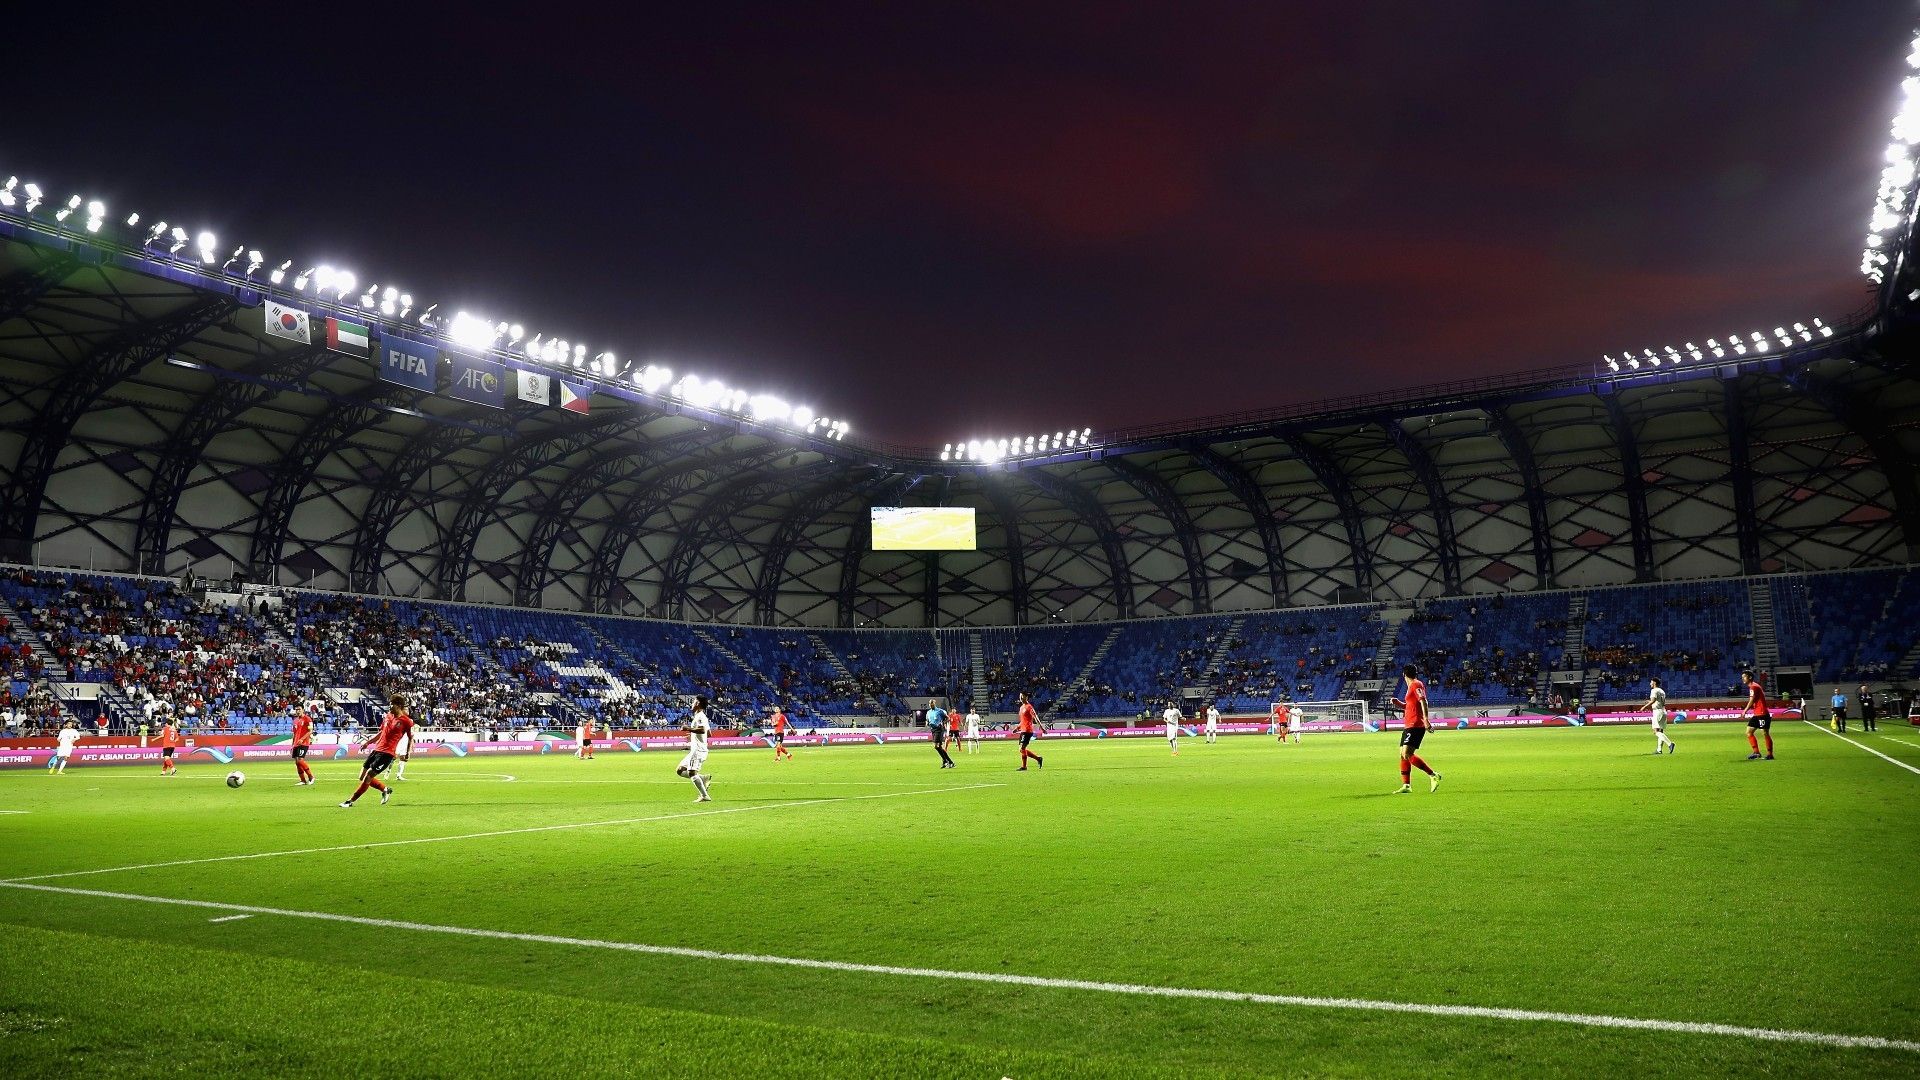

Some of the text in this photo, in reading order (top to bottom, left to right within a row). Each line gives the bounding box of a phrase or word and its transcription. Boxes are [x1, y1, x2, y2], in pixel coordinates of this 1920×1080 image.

[389, 350, 428, 377] FIFA
[457, 368, 498, 393] AFC
[70, 688, 80, 697] 11
[340, 692, 349, 701] 12
